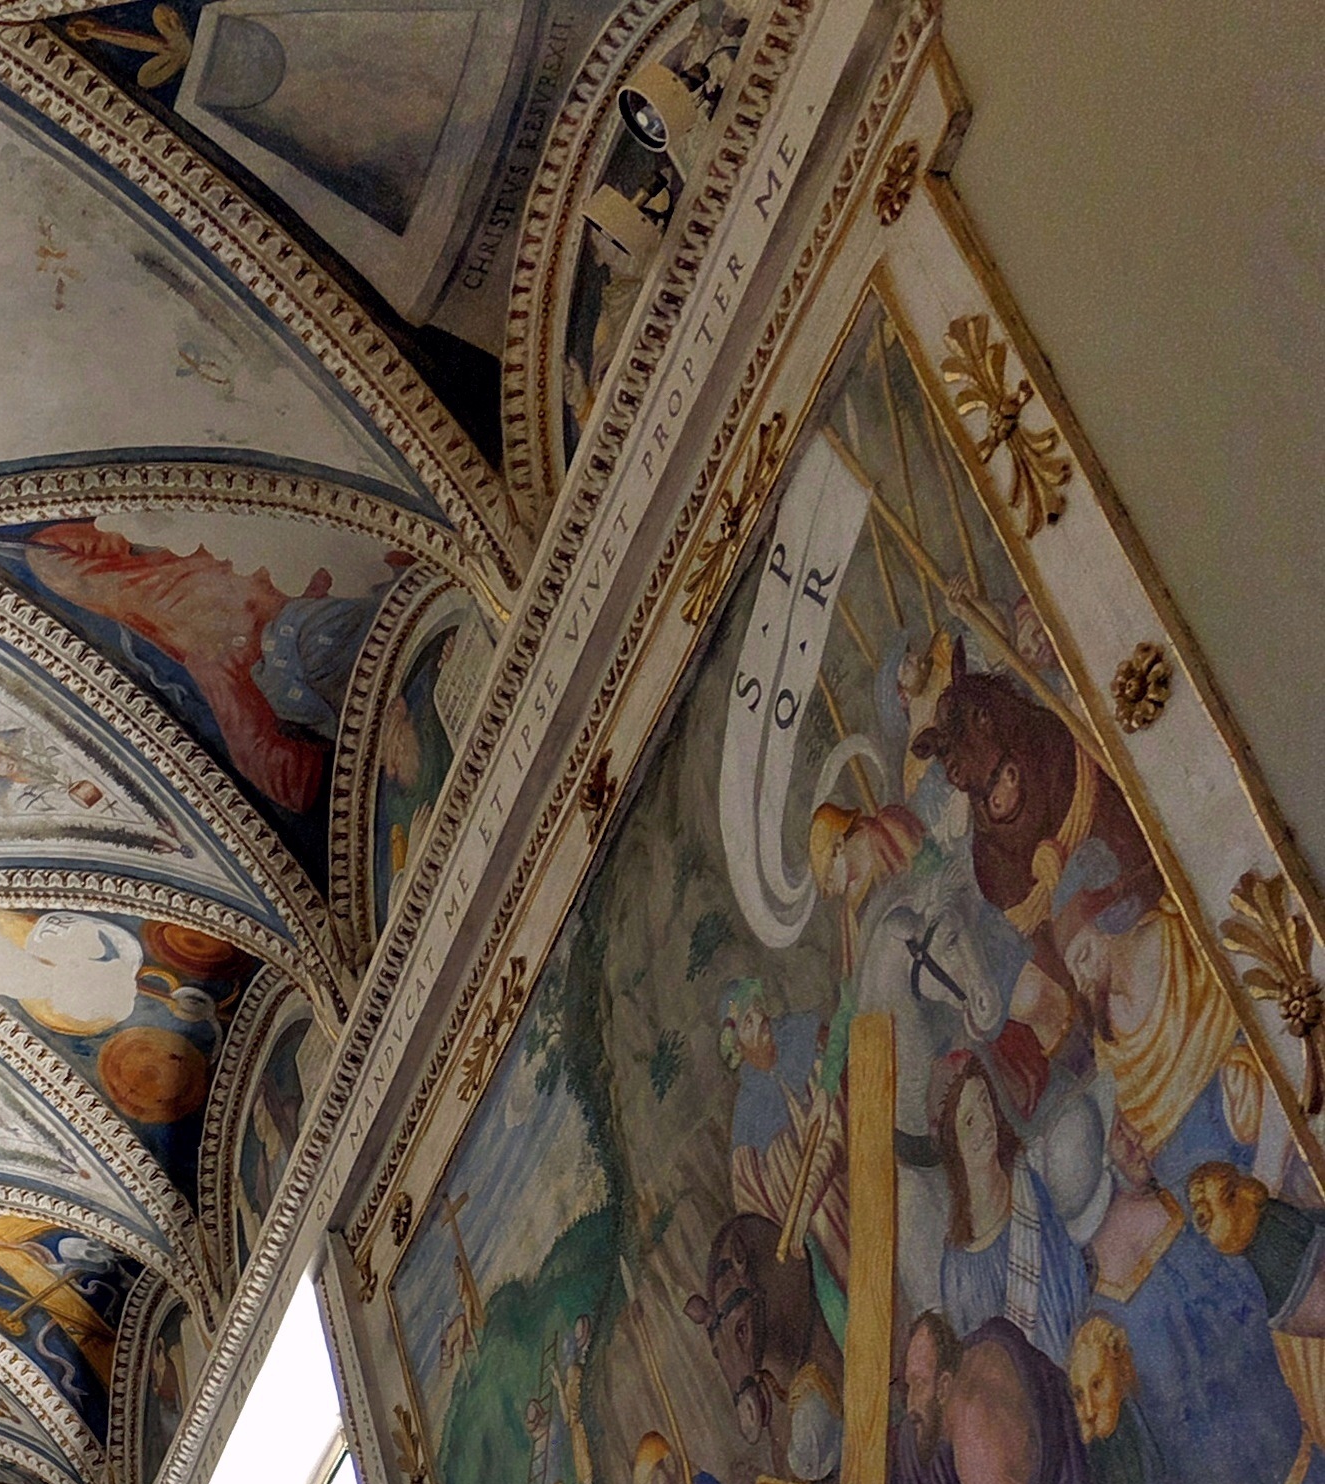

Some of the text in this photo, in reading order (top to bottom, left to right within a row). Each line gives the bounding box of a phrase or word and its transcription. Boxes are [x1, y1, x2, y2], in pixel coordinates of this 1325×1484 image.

[462, 163, 530, 290] CHRISTVS
[230, 1319, 278, 1409] PATREM
[315, 1164, 341, 1222] QVI
[348, 947, 436, 1152] MANDVCAT
[444, 868, 470, 931] ME
[479, 784, 504, 848] ET
[512, 669, 559, 774] IPSE
[564, 501, 629, 643] VIVET
[640, 252, 746, 479] PROPTER
[753, 133, 798, 222] ME
